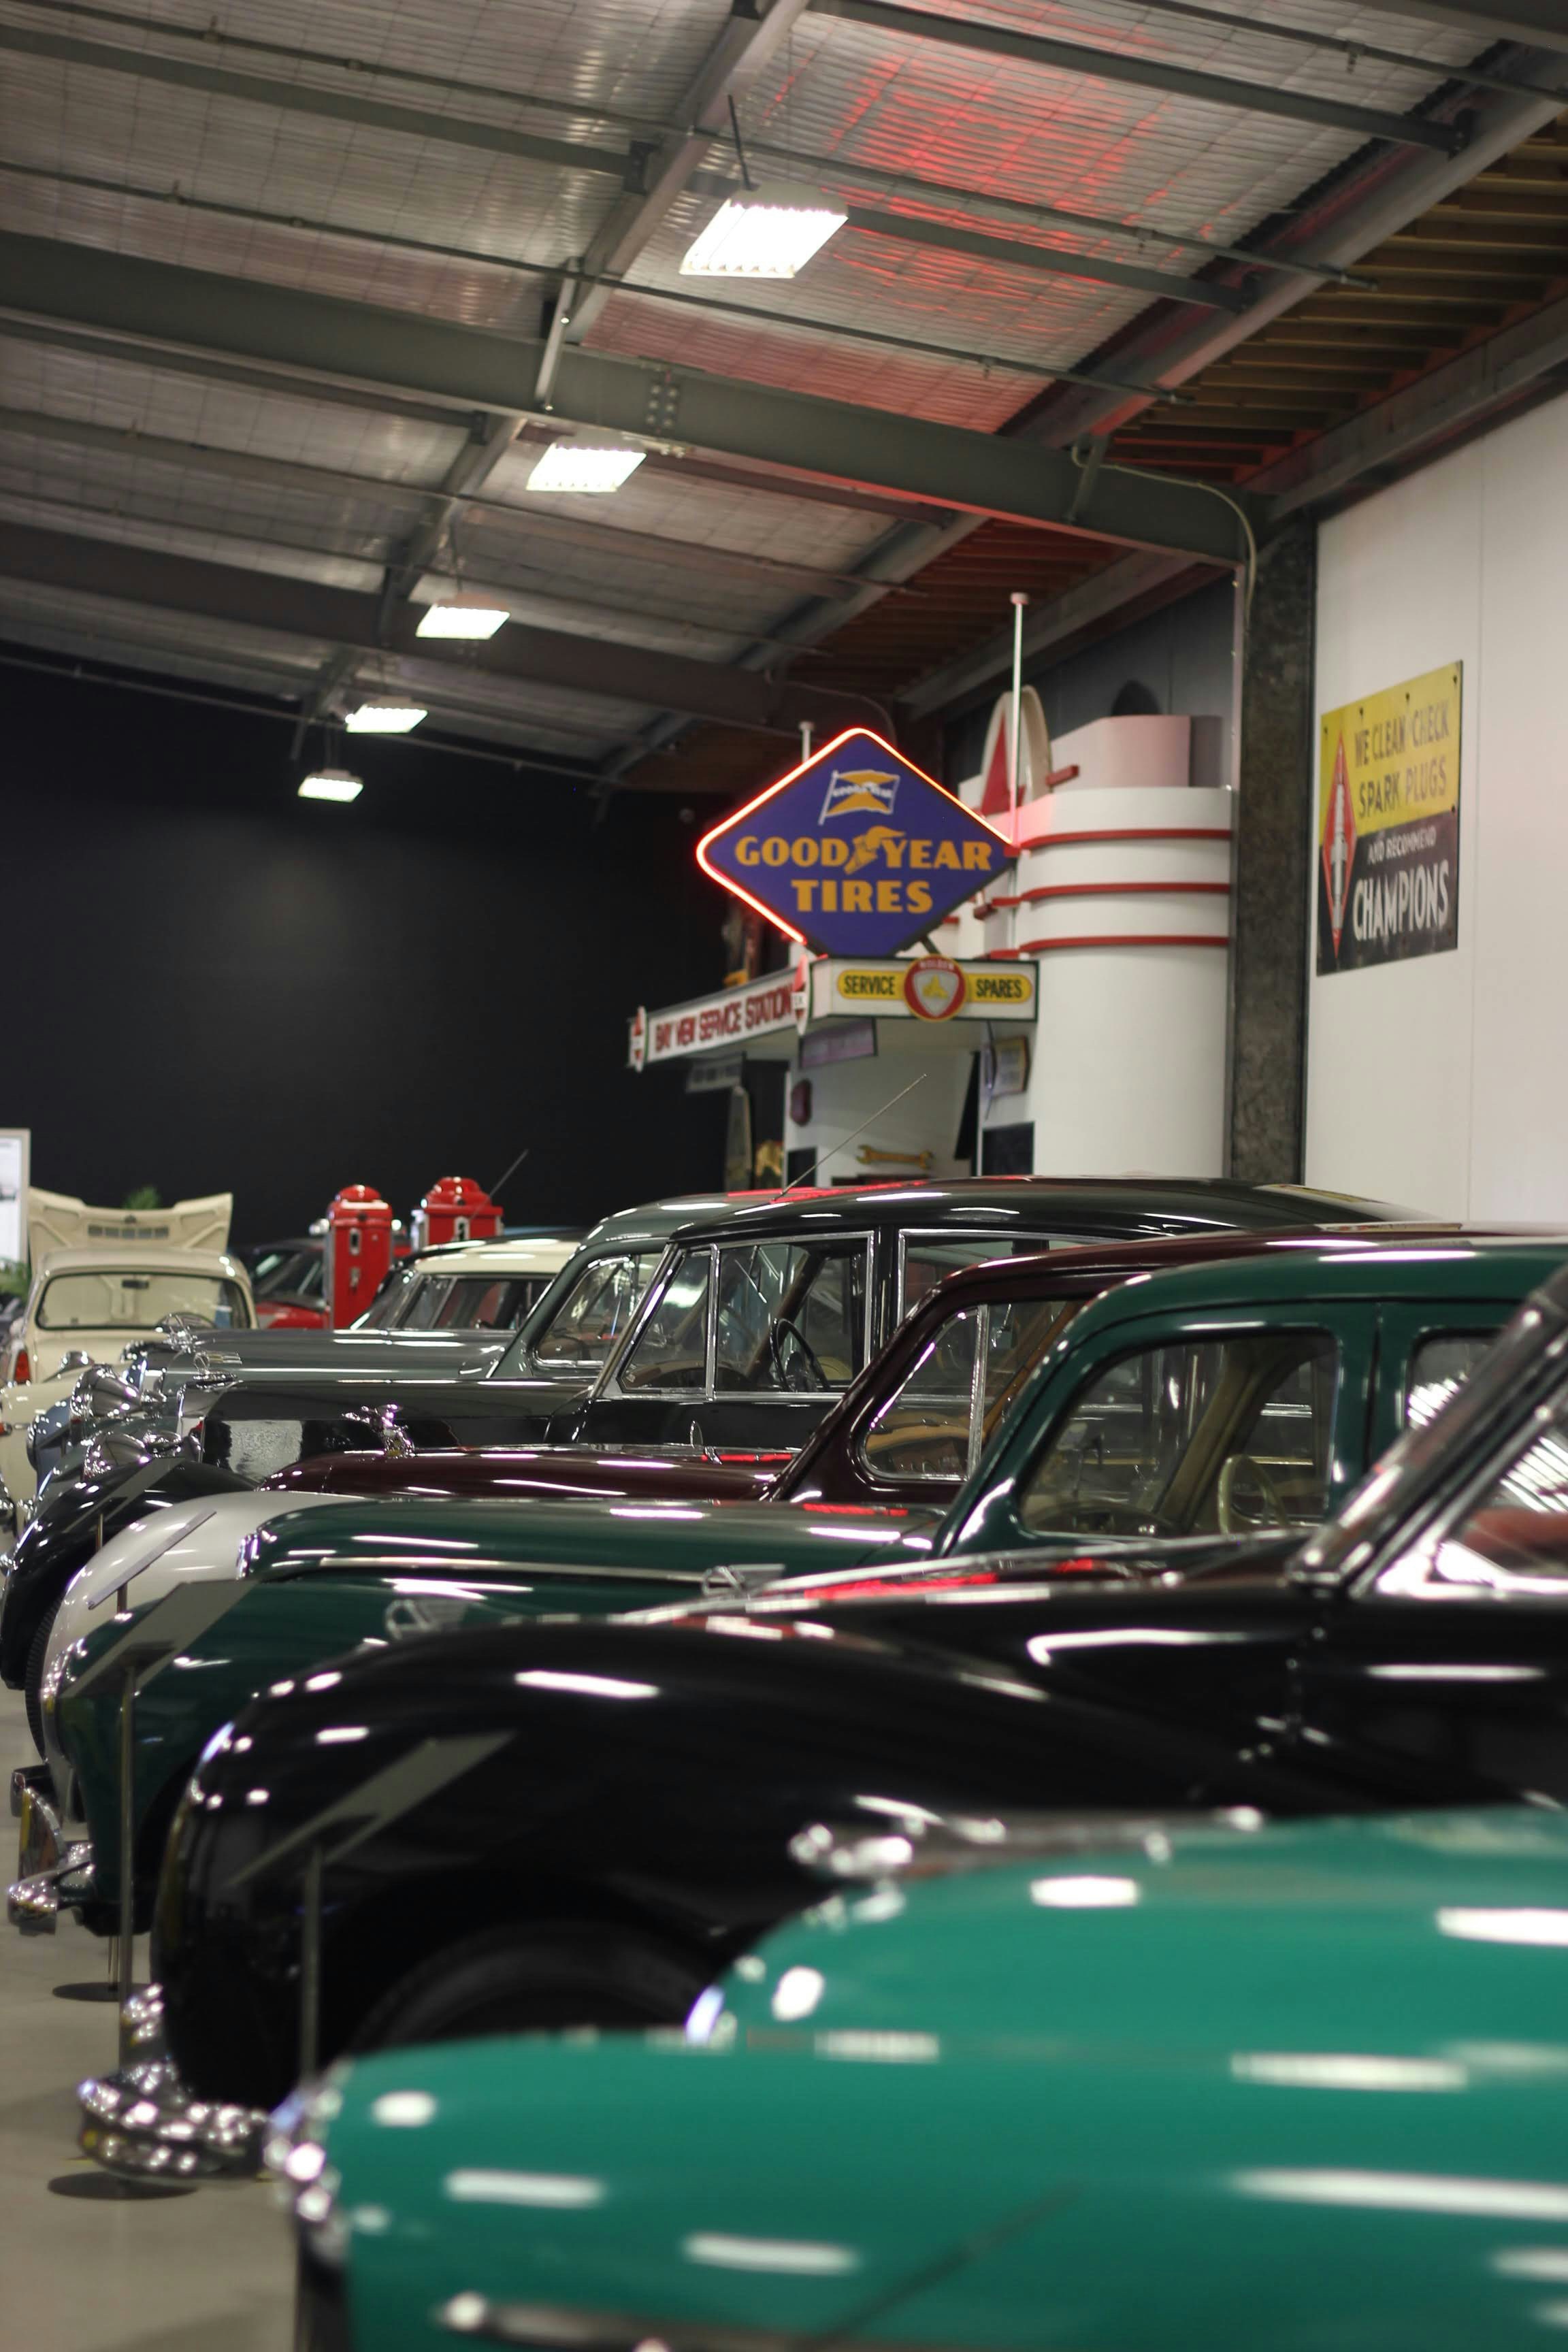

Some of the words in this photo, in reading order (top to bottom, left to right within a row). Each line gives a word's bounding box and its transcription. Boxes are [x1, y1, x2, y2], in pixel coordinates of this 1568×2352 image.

[1354, 729, 1370, 768] WE
[1372, 715, 1406, 761] CLEAN
[1358, 770, 1401, 819] SPARK
[1405, 755, 1447, 805] PLUGS
[1367, 839, 1384, 866] AND
[1386, 825, 1437, 860] RECOMMEND
[790, 879, 934, 914] TIRES
[1352, 859, 1450, 941] CHAMPIONS
[843, 975, 896, 996] SERVICE
[976, 978, 1022, 998] SPARES
[699, 1000, 742, 1041] SERVICE
